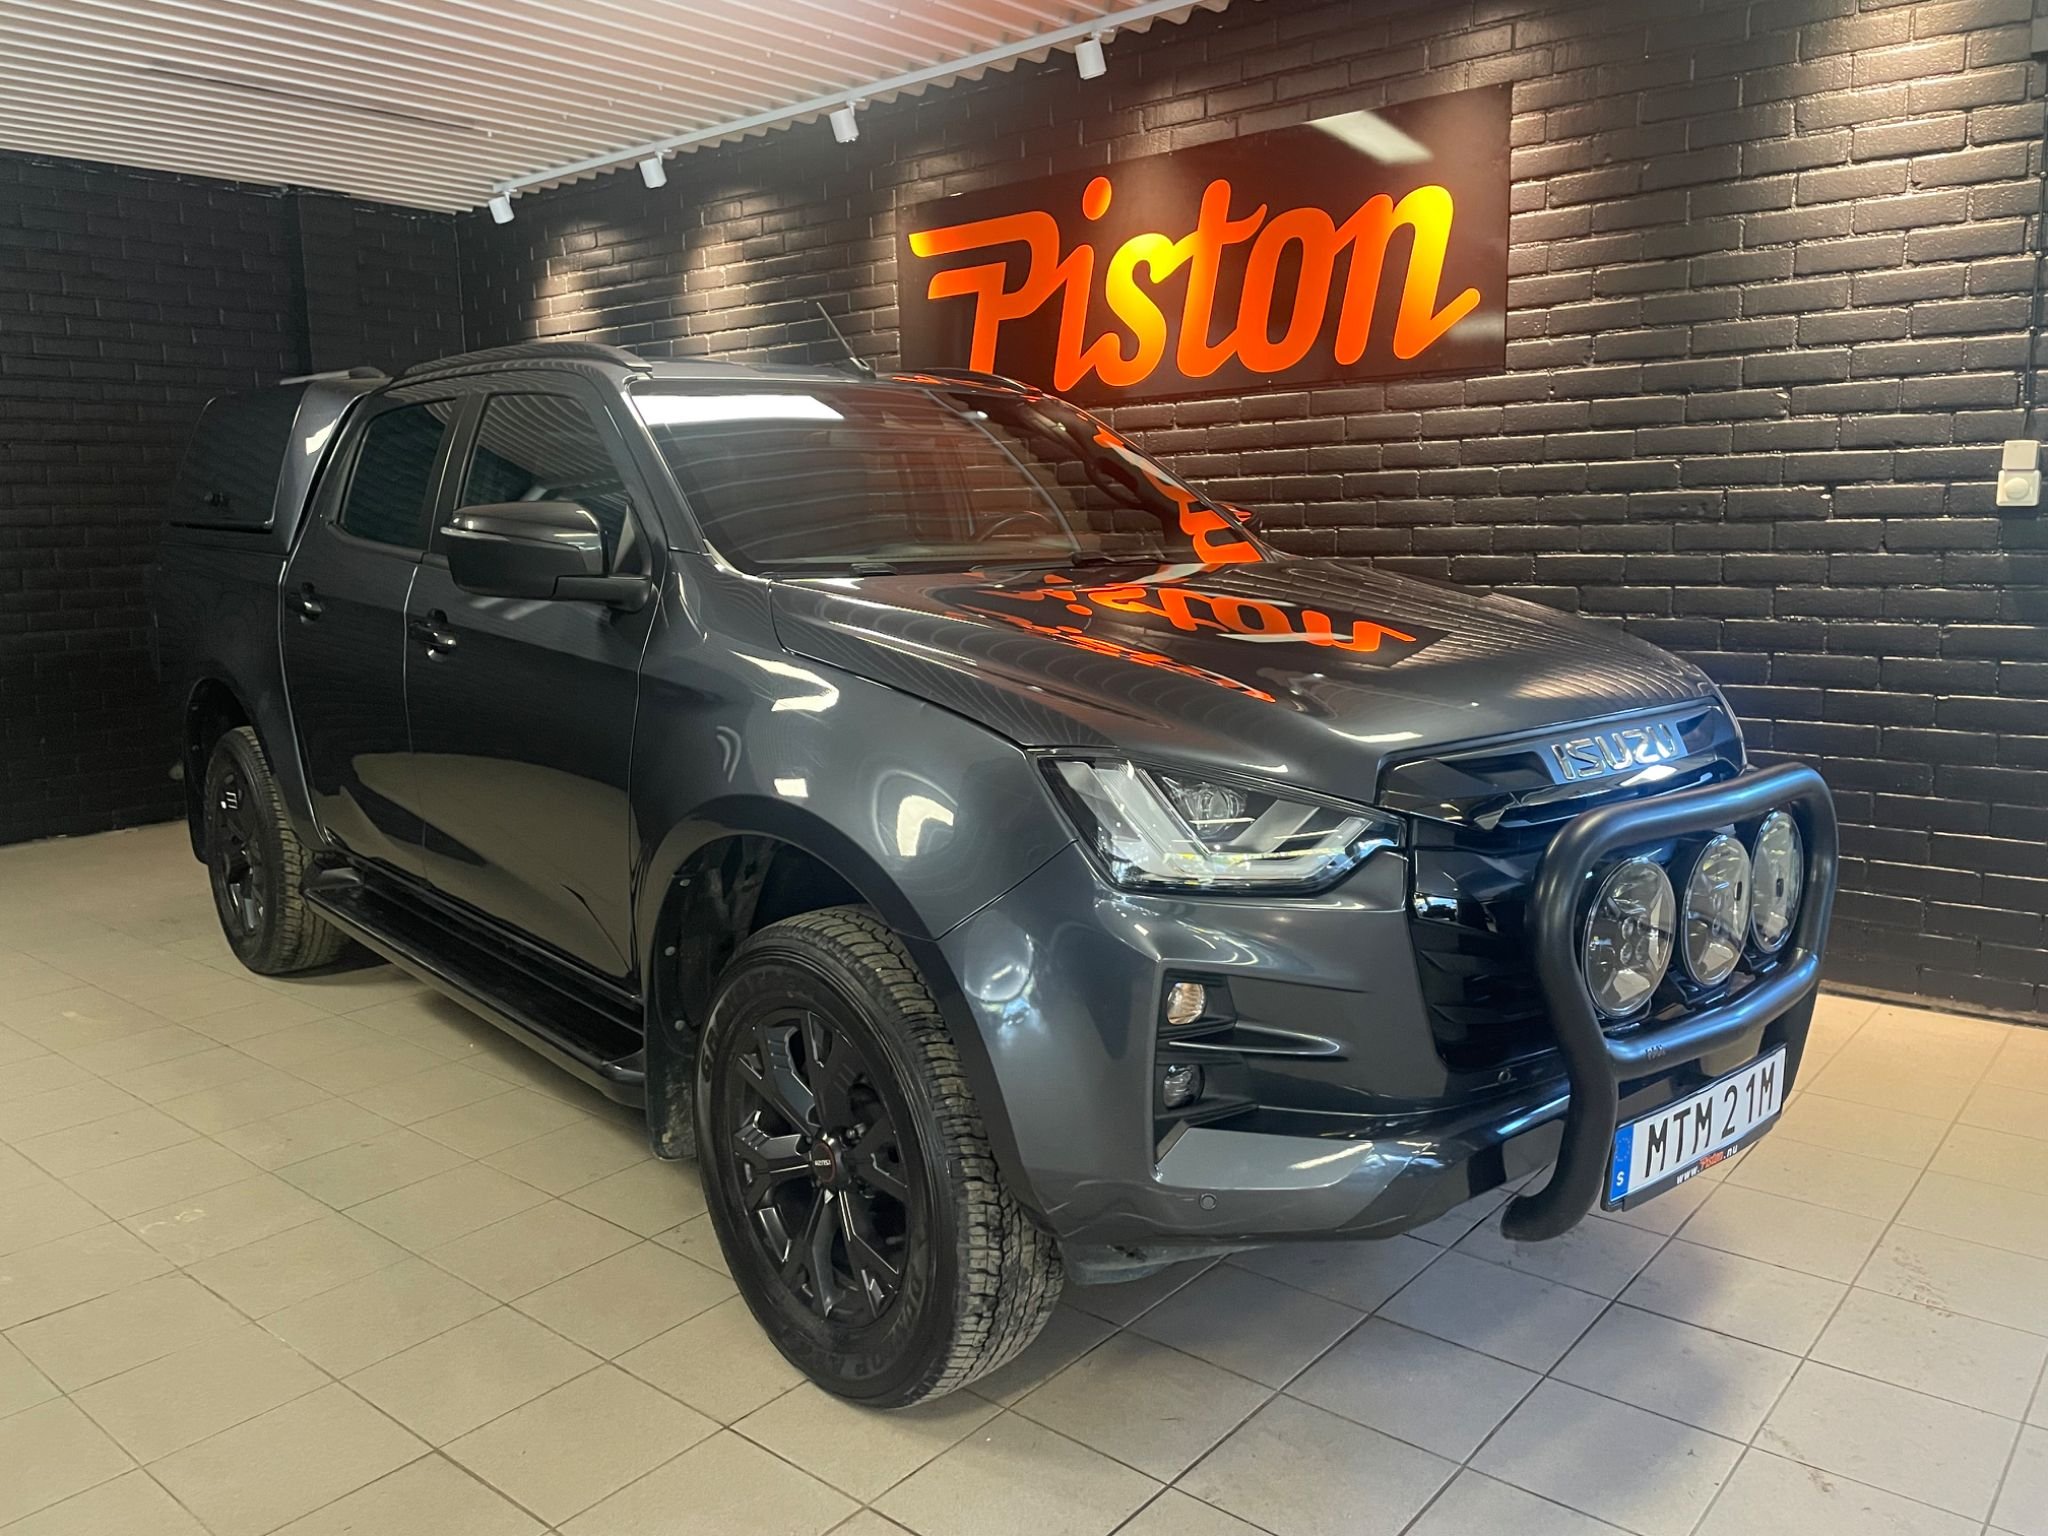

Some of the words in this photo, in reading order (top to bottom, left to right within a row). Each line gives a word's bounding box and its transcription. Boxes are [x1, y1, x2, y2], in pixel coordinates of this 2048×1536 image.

[909, 176, 1481, 392] Piston
[1551, 723, 1676, 780] ISUZU
[1644, 1096, 1713, 1178] MTM
[1721, 1061, 1776, 1140] 21M
[1616, 1171, 1625, 1187] S
